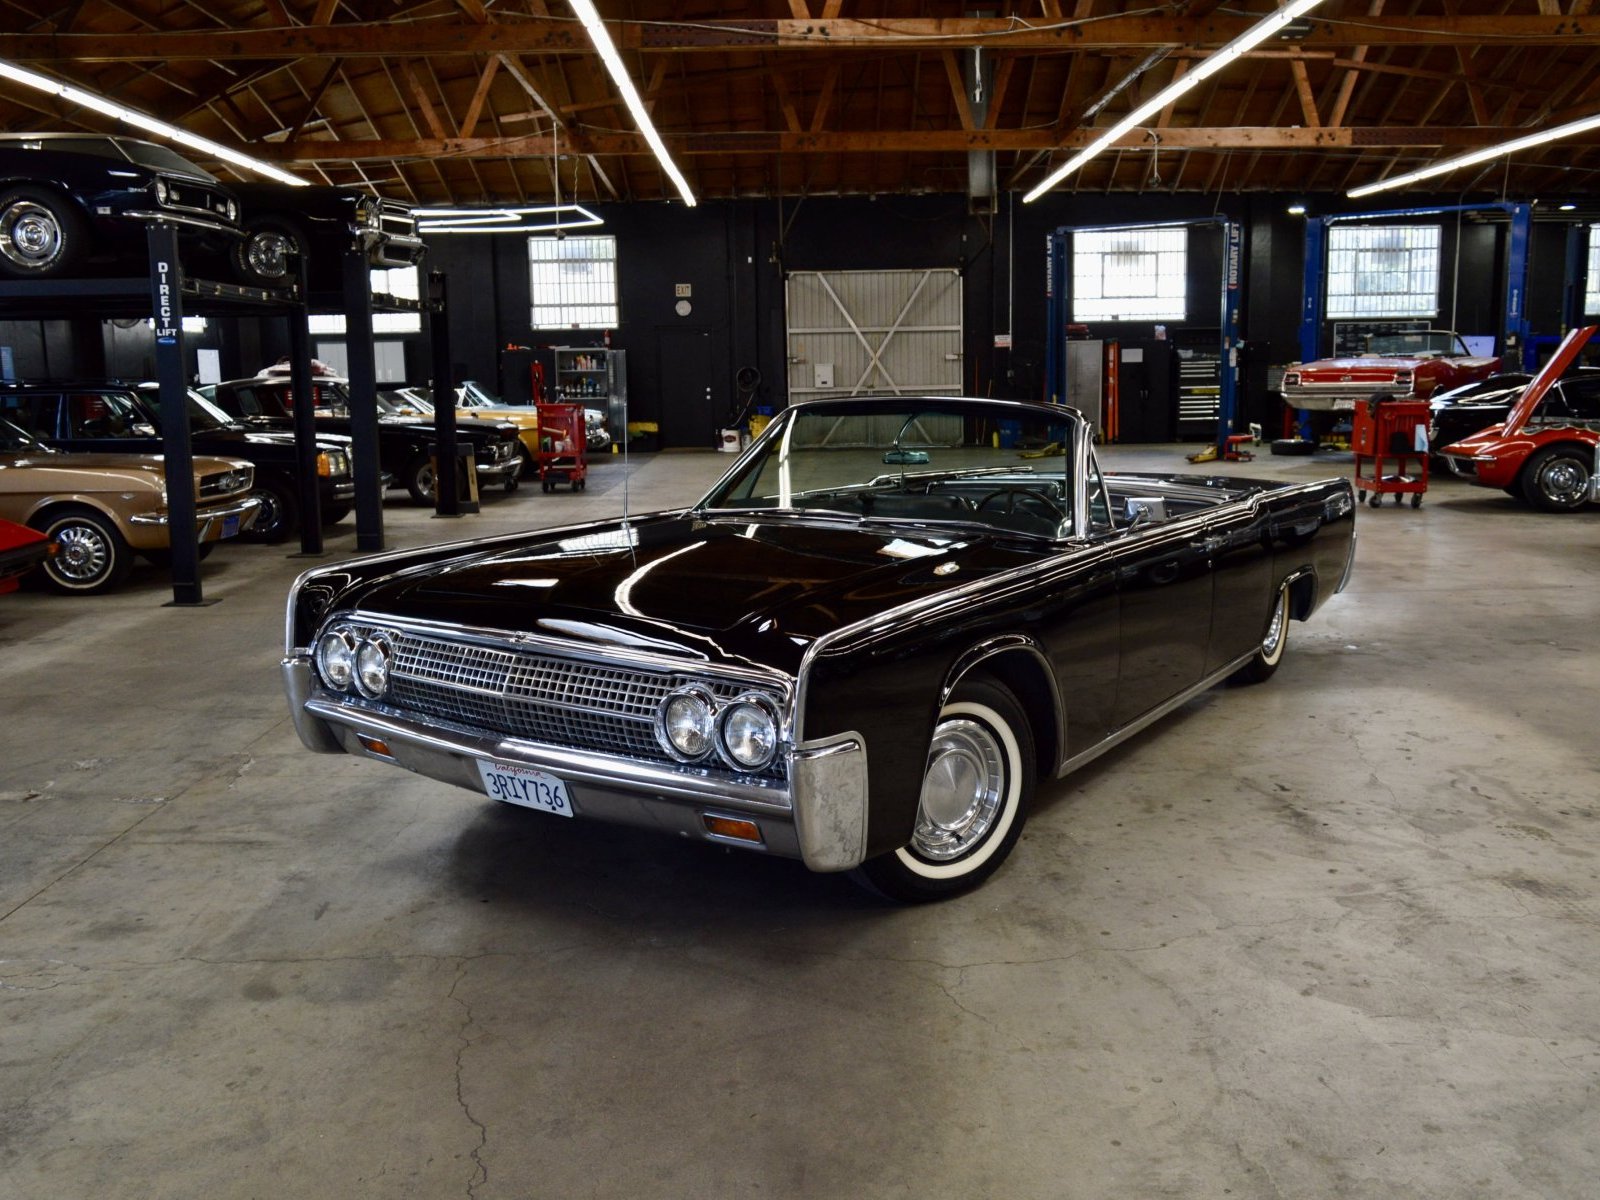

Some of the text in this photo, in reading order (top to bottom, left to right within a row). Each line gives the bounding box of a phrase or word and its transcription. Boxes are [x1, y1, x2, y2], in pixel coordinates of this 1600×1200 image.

[1229, 222, 1240, 285] ROTARY LIFT
[157, 262, 171, 328] DIRECT
[676, 285, 690, 295] EXIT
[156, 328, 177, 336] LIFT
[486, 772, 564, 808] 3RIY736
